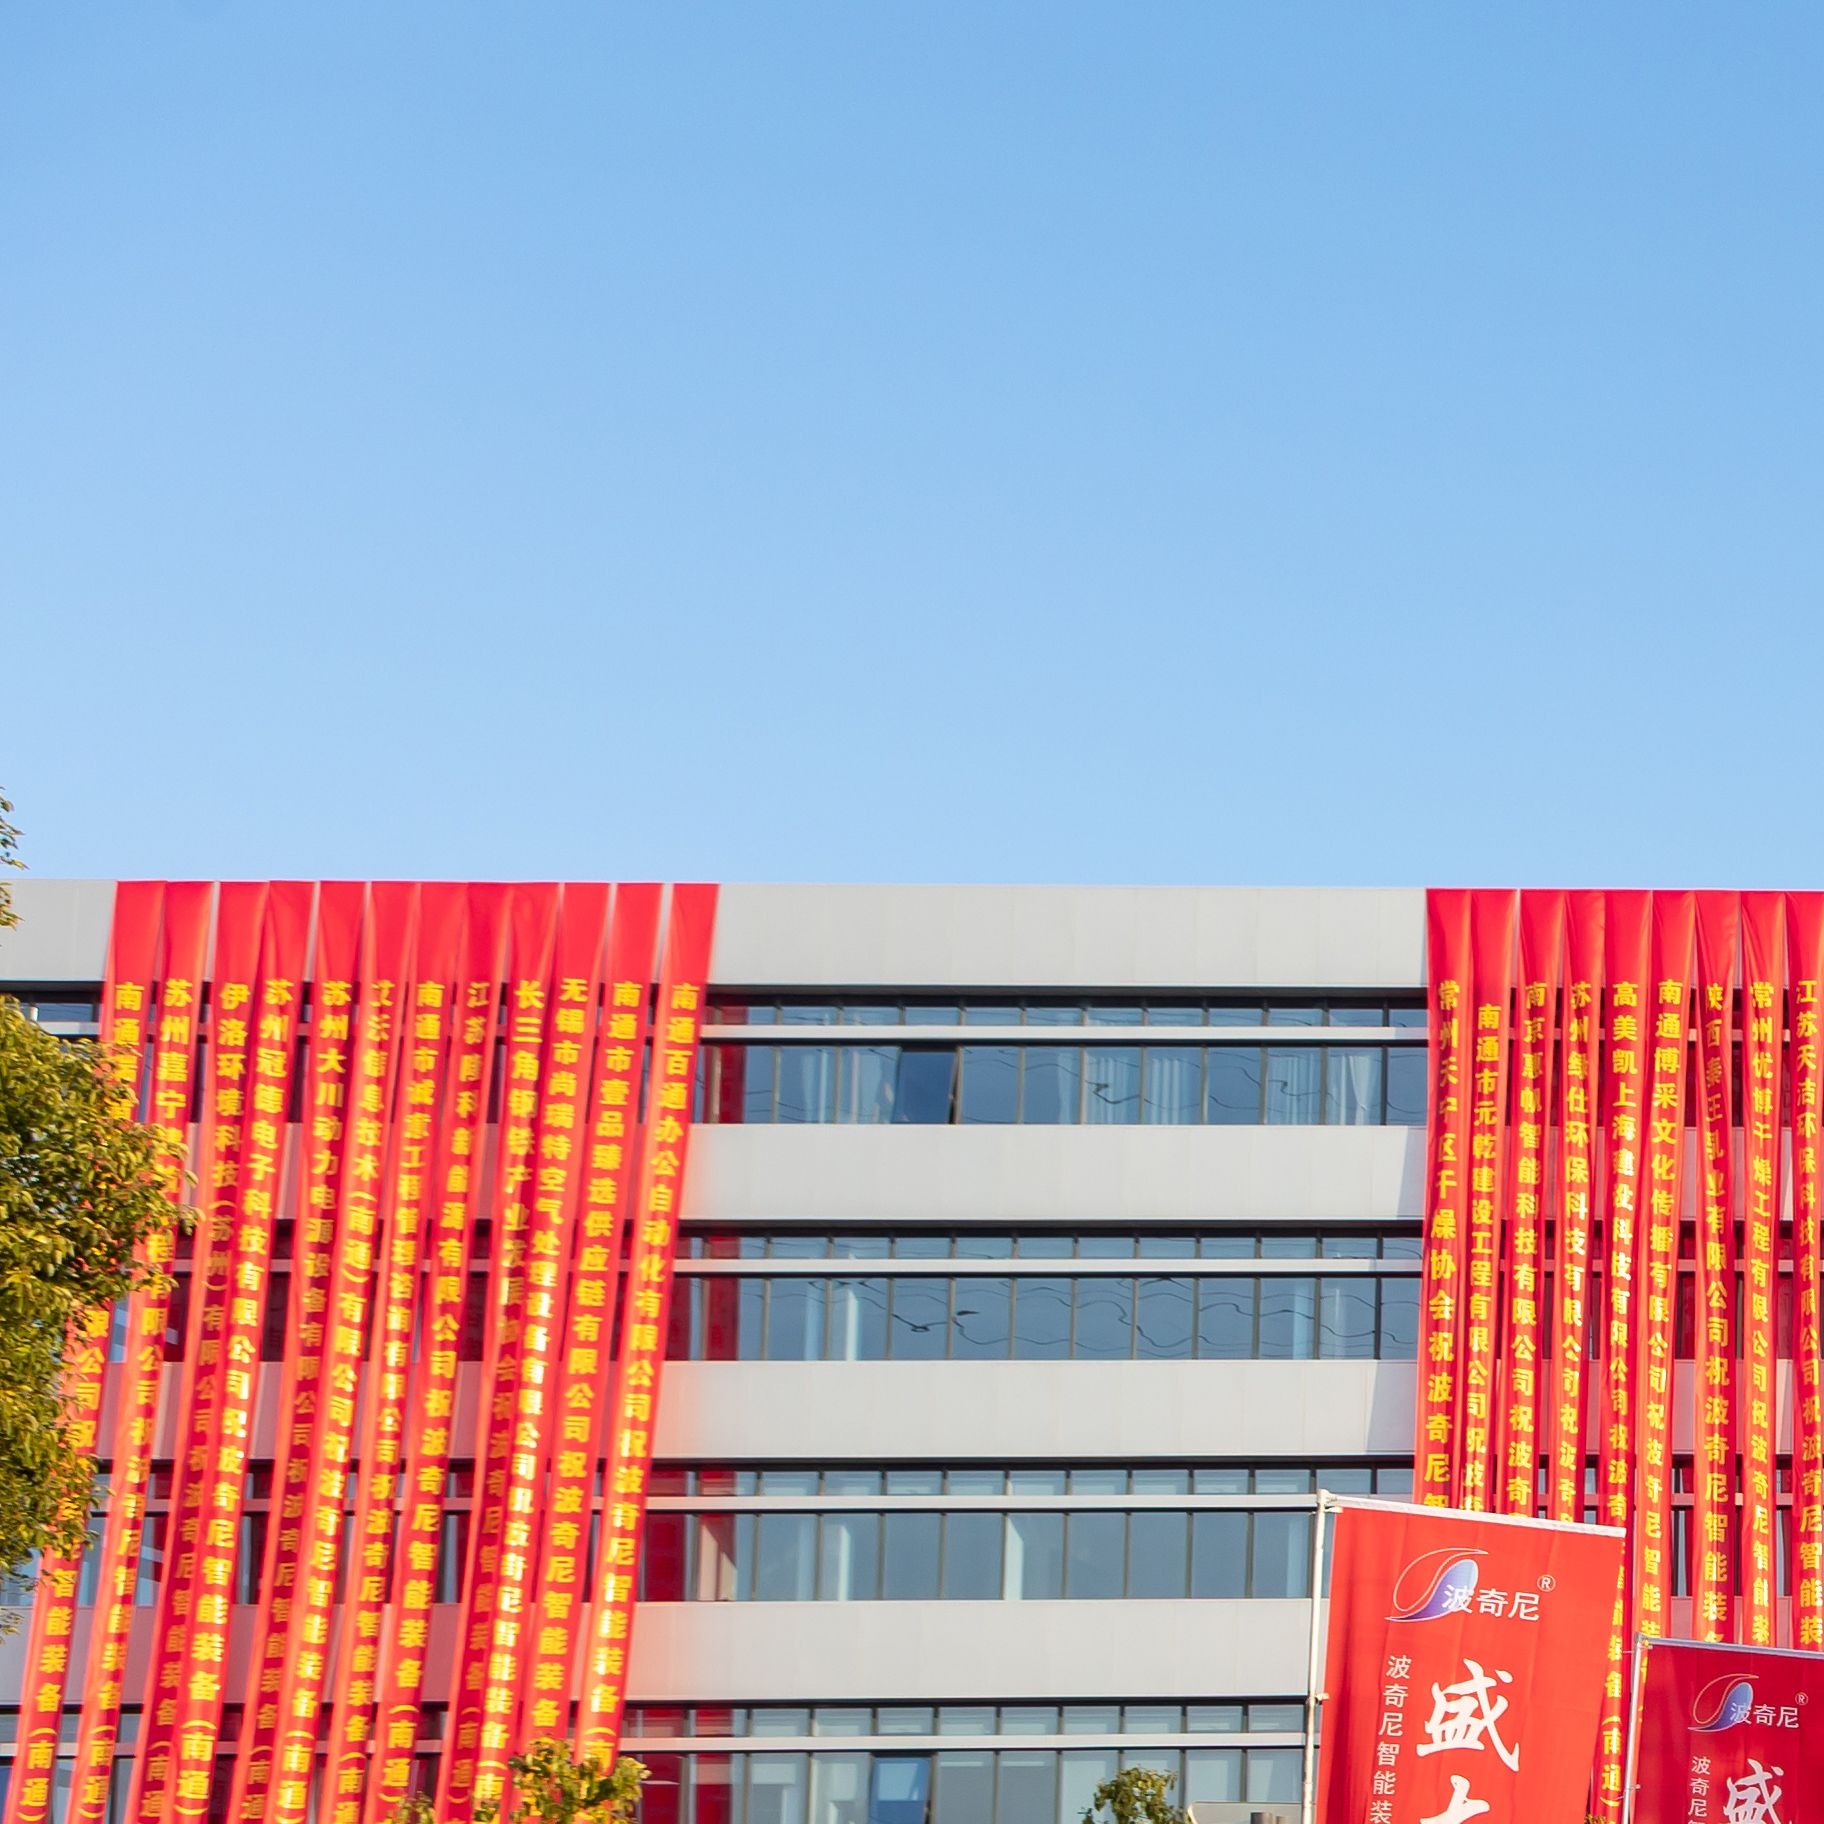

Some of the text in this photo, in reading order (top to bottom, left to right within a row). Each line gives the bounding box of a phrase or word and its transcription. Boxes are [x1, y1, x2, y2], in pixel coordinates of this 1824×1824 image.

[1443, 1583, 1541, 1622] 波奇尼
[1730, 1700, 1800, 1729] 波奇尼
